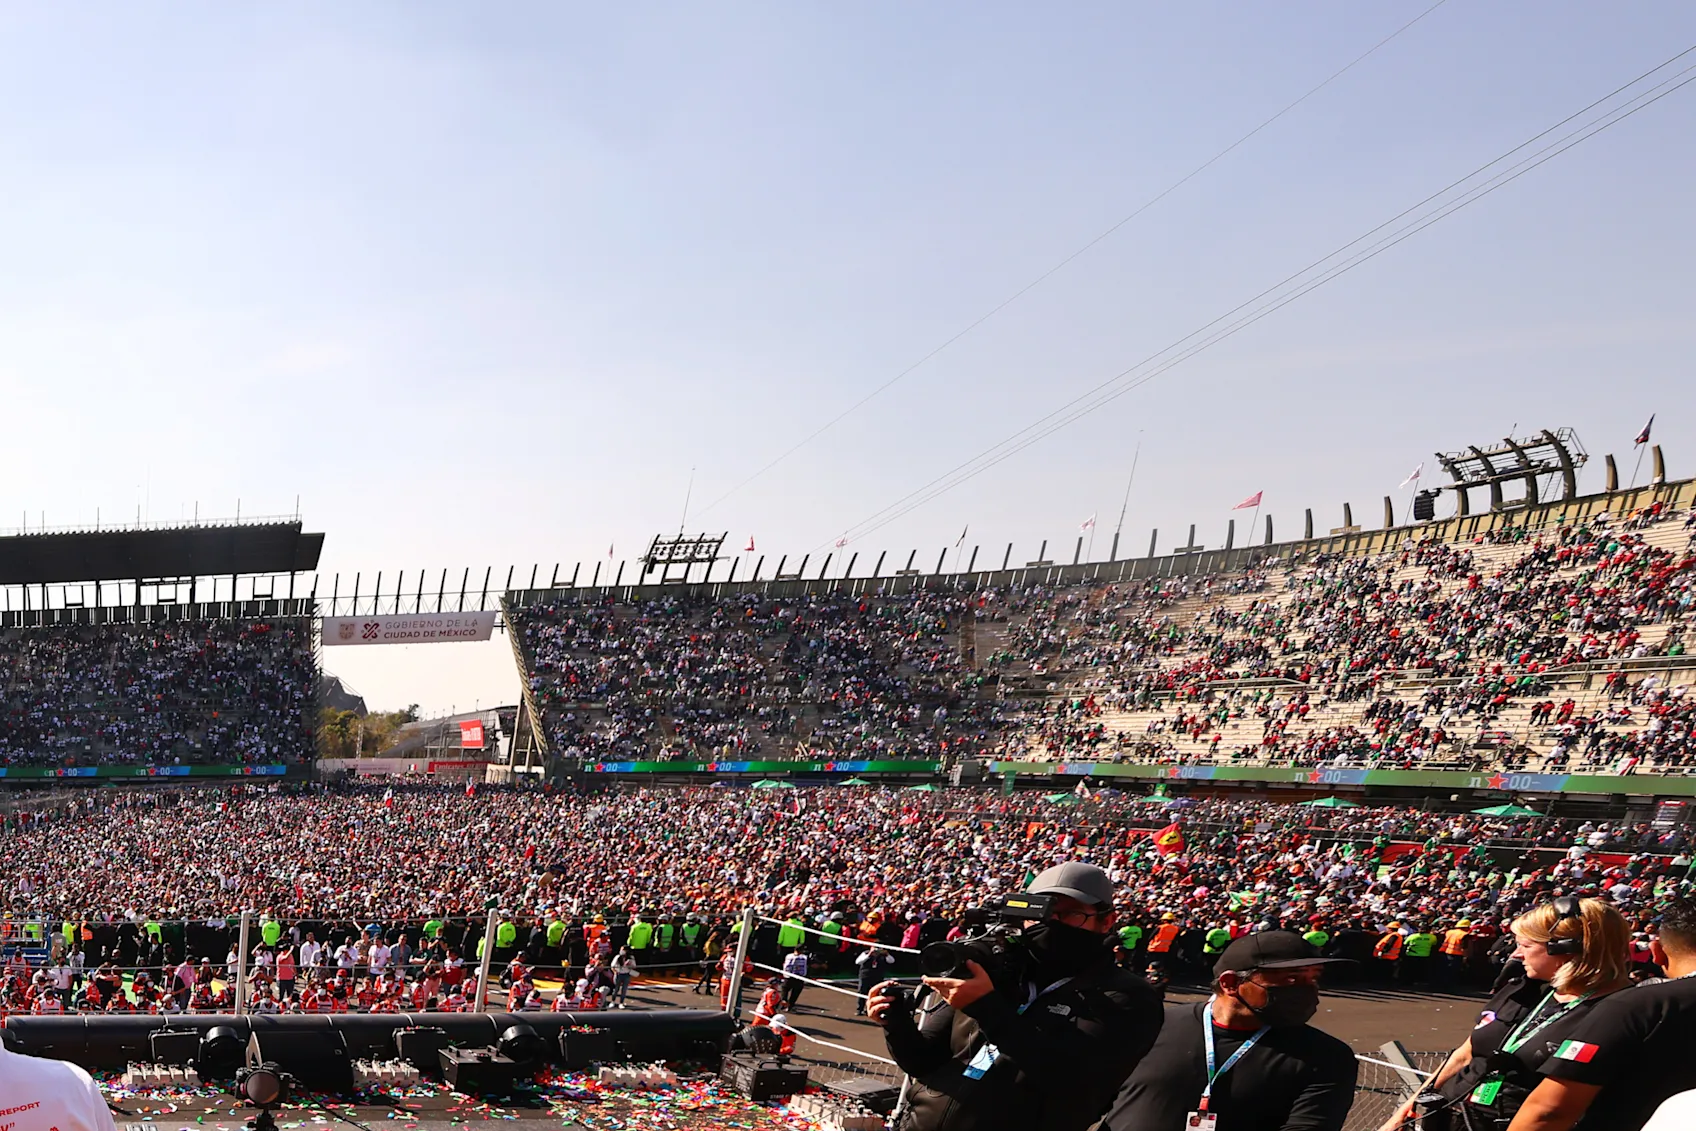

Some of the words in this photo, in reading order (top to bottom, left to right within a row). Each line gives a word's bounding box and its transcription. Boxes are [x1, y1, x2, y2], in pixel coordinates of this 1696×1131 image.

[385, 620, 442, 629] GOBIERNO
[446, 619, 461, 628] DE
[464, 618, 478, 627] LA
[384, 630, 420, 639] CIUDAD
[423, 630, 435, 638] DE
[438, 627, 476, 637] MÉXICO
